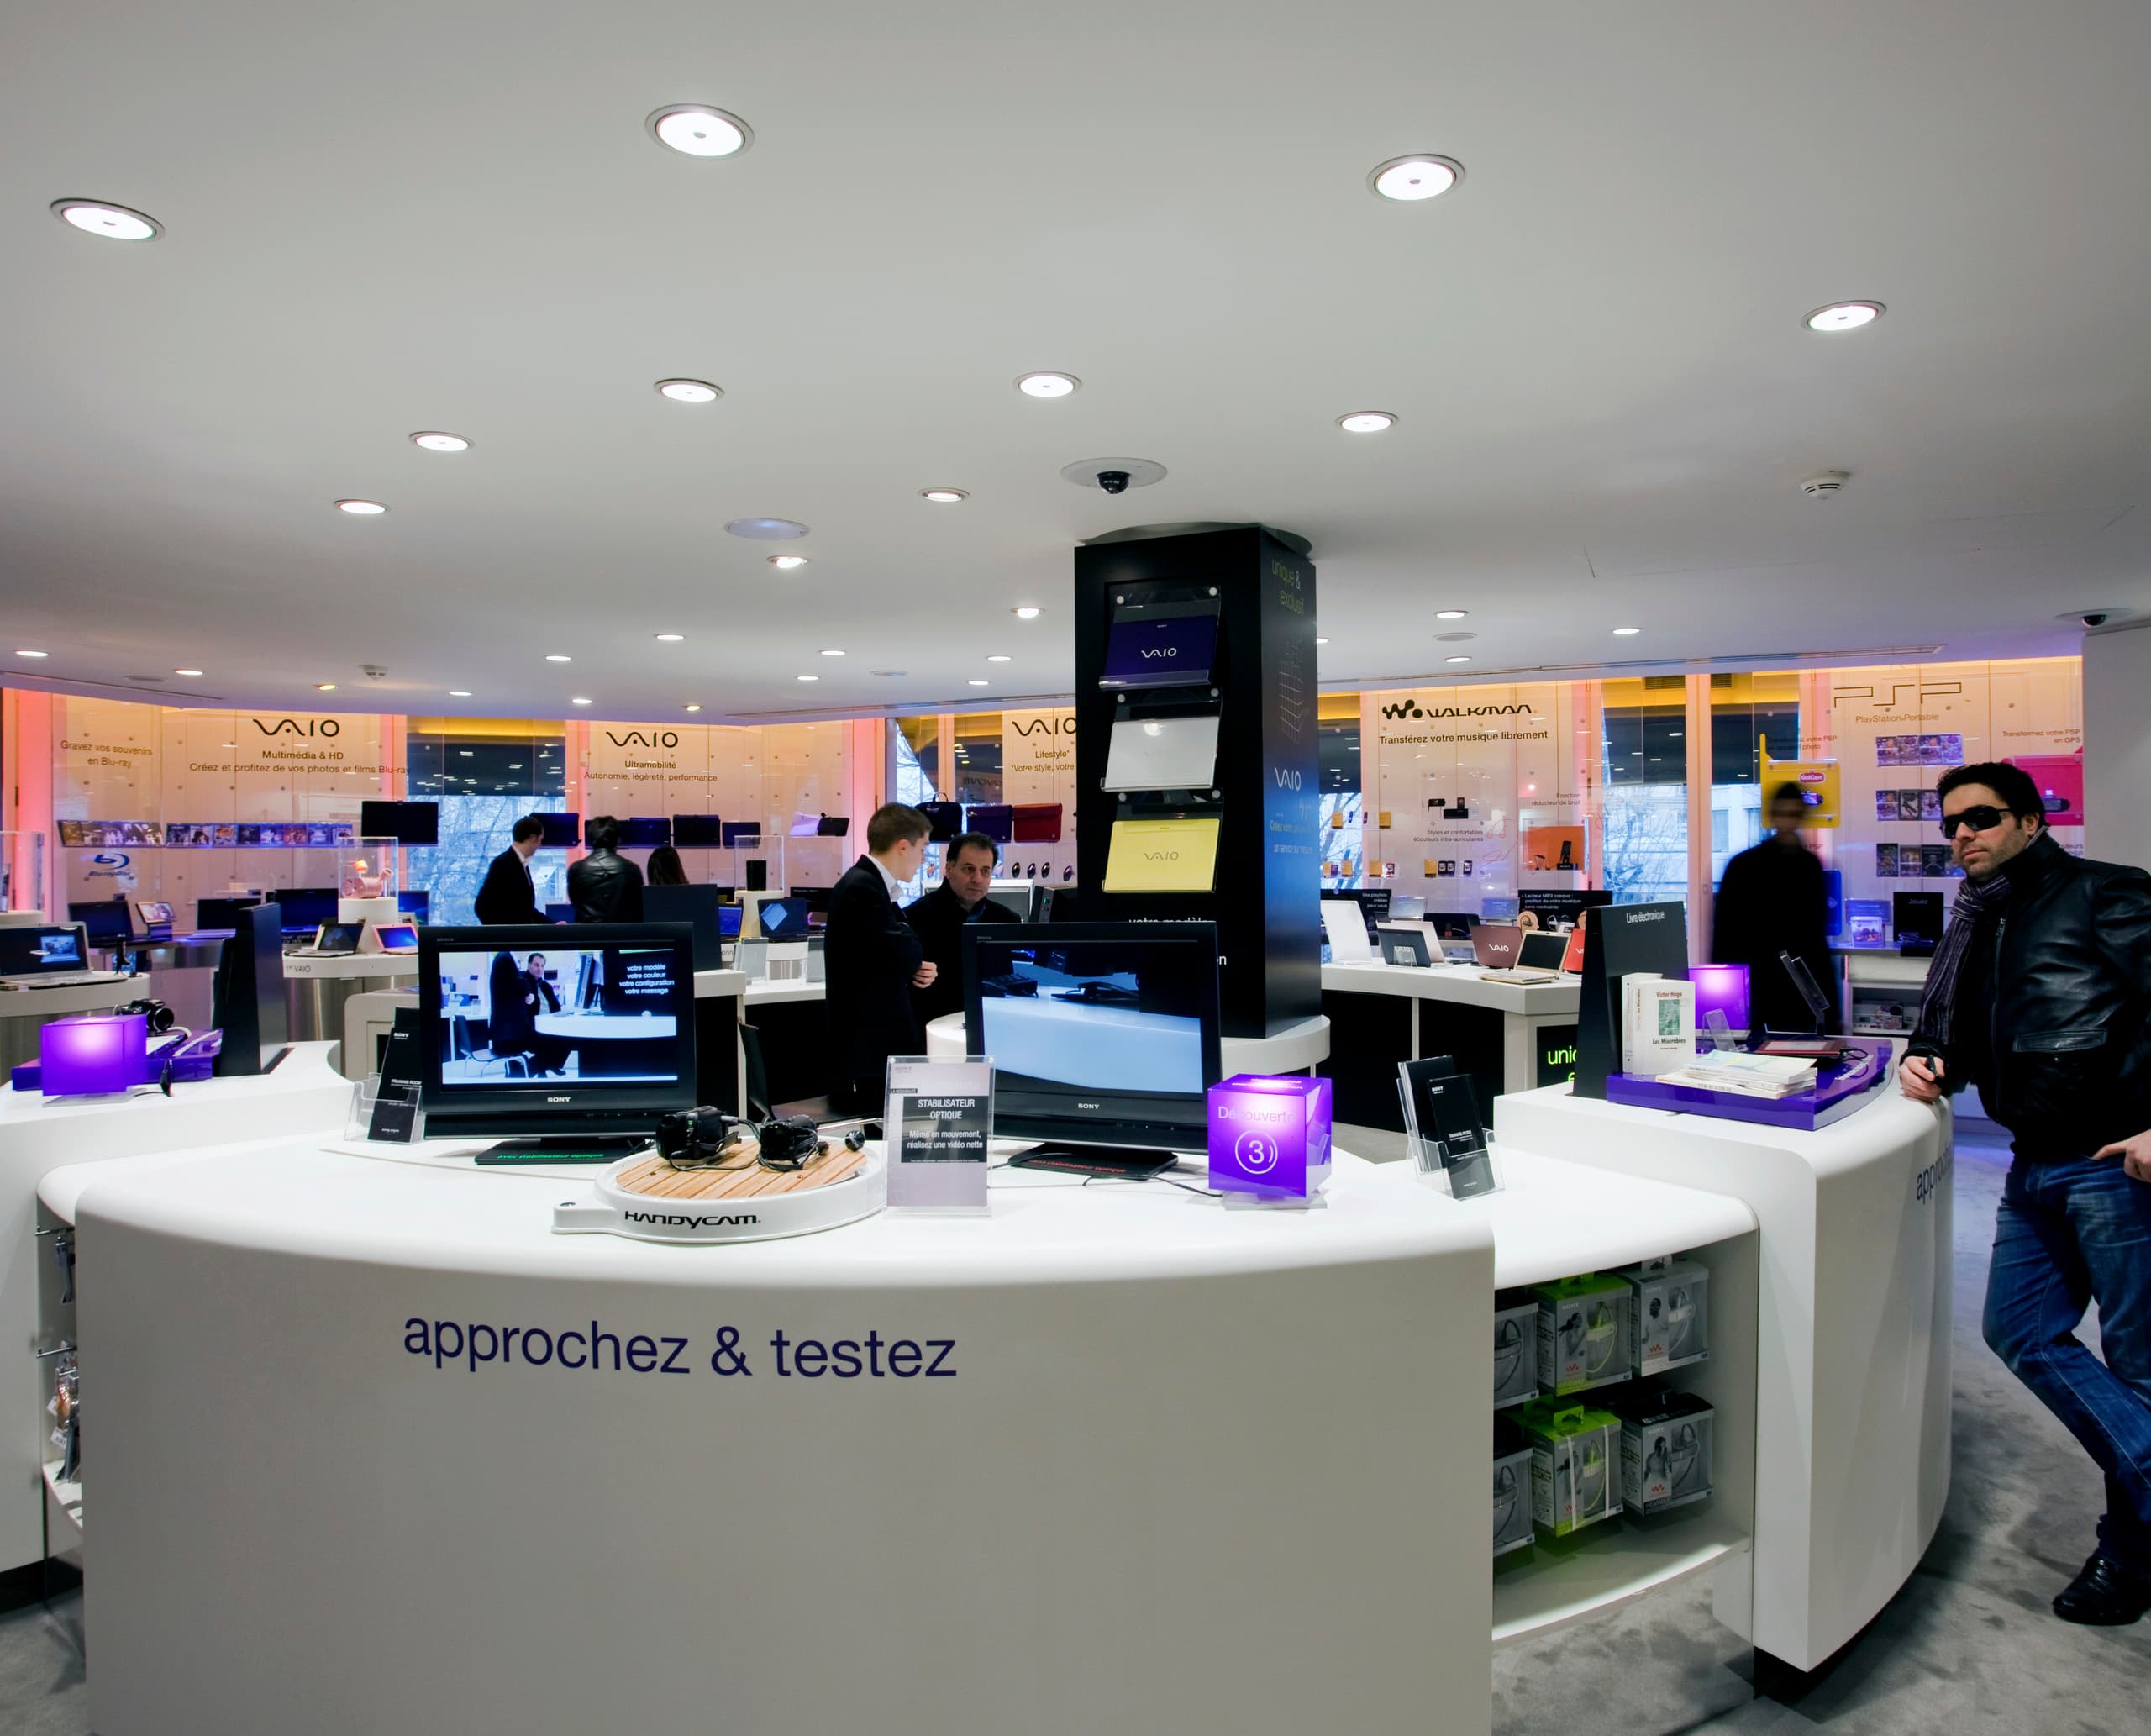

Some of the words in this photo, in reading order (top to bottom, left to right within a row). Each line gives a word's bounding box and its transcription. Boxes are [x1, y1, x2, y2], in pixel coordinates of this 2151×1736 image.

[1141, 647, 1177, 658] VAIO
[1833, 682, 1962, 708] PSP
[1427, 704, 1533, 718] WALKMAN
[253, 718, 340, 737] VAIO
[1012, 717, 1077, 736] VAIO
[606, 731, 678, 748] VAIO
[1380, 734, 1428, 744] Transférez
[1457, 732, 1499, 743] musique
[1501, 730, 1549, 740] librement
[60, 739, 92, 751] Gravez
[95, 744, 110, 753] vos
[113, 745, 153, 755] souvenirs
[262, 750, 316, 760] Multimédia
[319, 751, 325, 760] &
[329, 751, 344, 760] HD
[102, 757, 132, 769] Blu-ray
[189, 762, 218, 772] Créez
[222, 764, 231, 772] et
[234, 763, 270, 775] profitez
[273, 764, 286, 772] de
[308, 765, 339, 776] photos
[343, 765, 352, 774] et
[354, 765, 376, 774] films
[379, 765, 410, 776] Blu-ray
[625, 760, 676, 770] Ultramobilité
[1034, 764, 1054, 773] style,
[1055, 763, 1075, 771] votre
[584, 771, 629, 781] Autonomie,
[668, 773, 718, 782] performance
[1275, 767, 1302, 792] VAIO
[1144, 851, 1179, 861] VAIO
[1626, 912, 1638, 924] Livre
[1638, 910, 1665, 923] électronique
[1488, 944, 1509, 952] VAIO
[918, 1098, 975, 1108] STABILISATEUR
[929, 1110, 962, 1120] OPTIQUE
[909, 1129, 931, 1139] Même
[941, 1130, 981, 1139] mouvement,
[907, 1140, 933, 1149] réalisez
[947, 1140, 965, 1149] vidéo
[965, 1140, 983, 1149] nette
[1249, 1139, 1265, 1164] 3
[624, 1210, 757, 1229] HANDYCAM
[404, 1317, 690, 1375] approchez
[710, 1325, 753, 1376] &
[770, 1329, 958, 1377] testez
